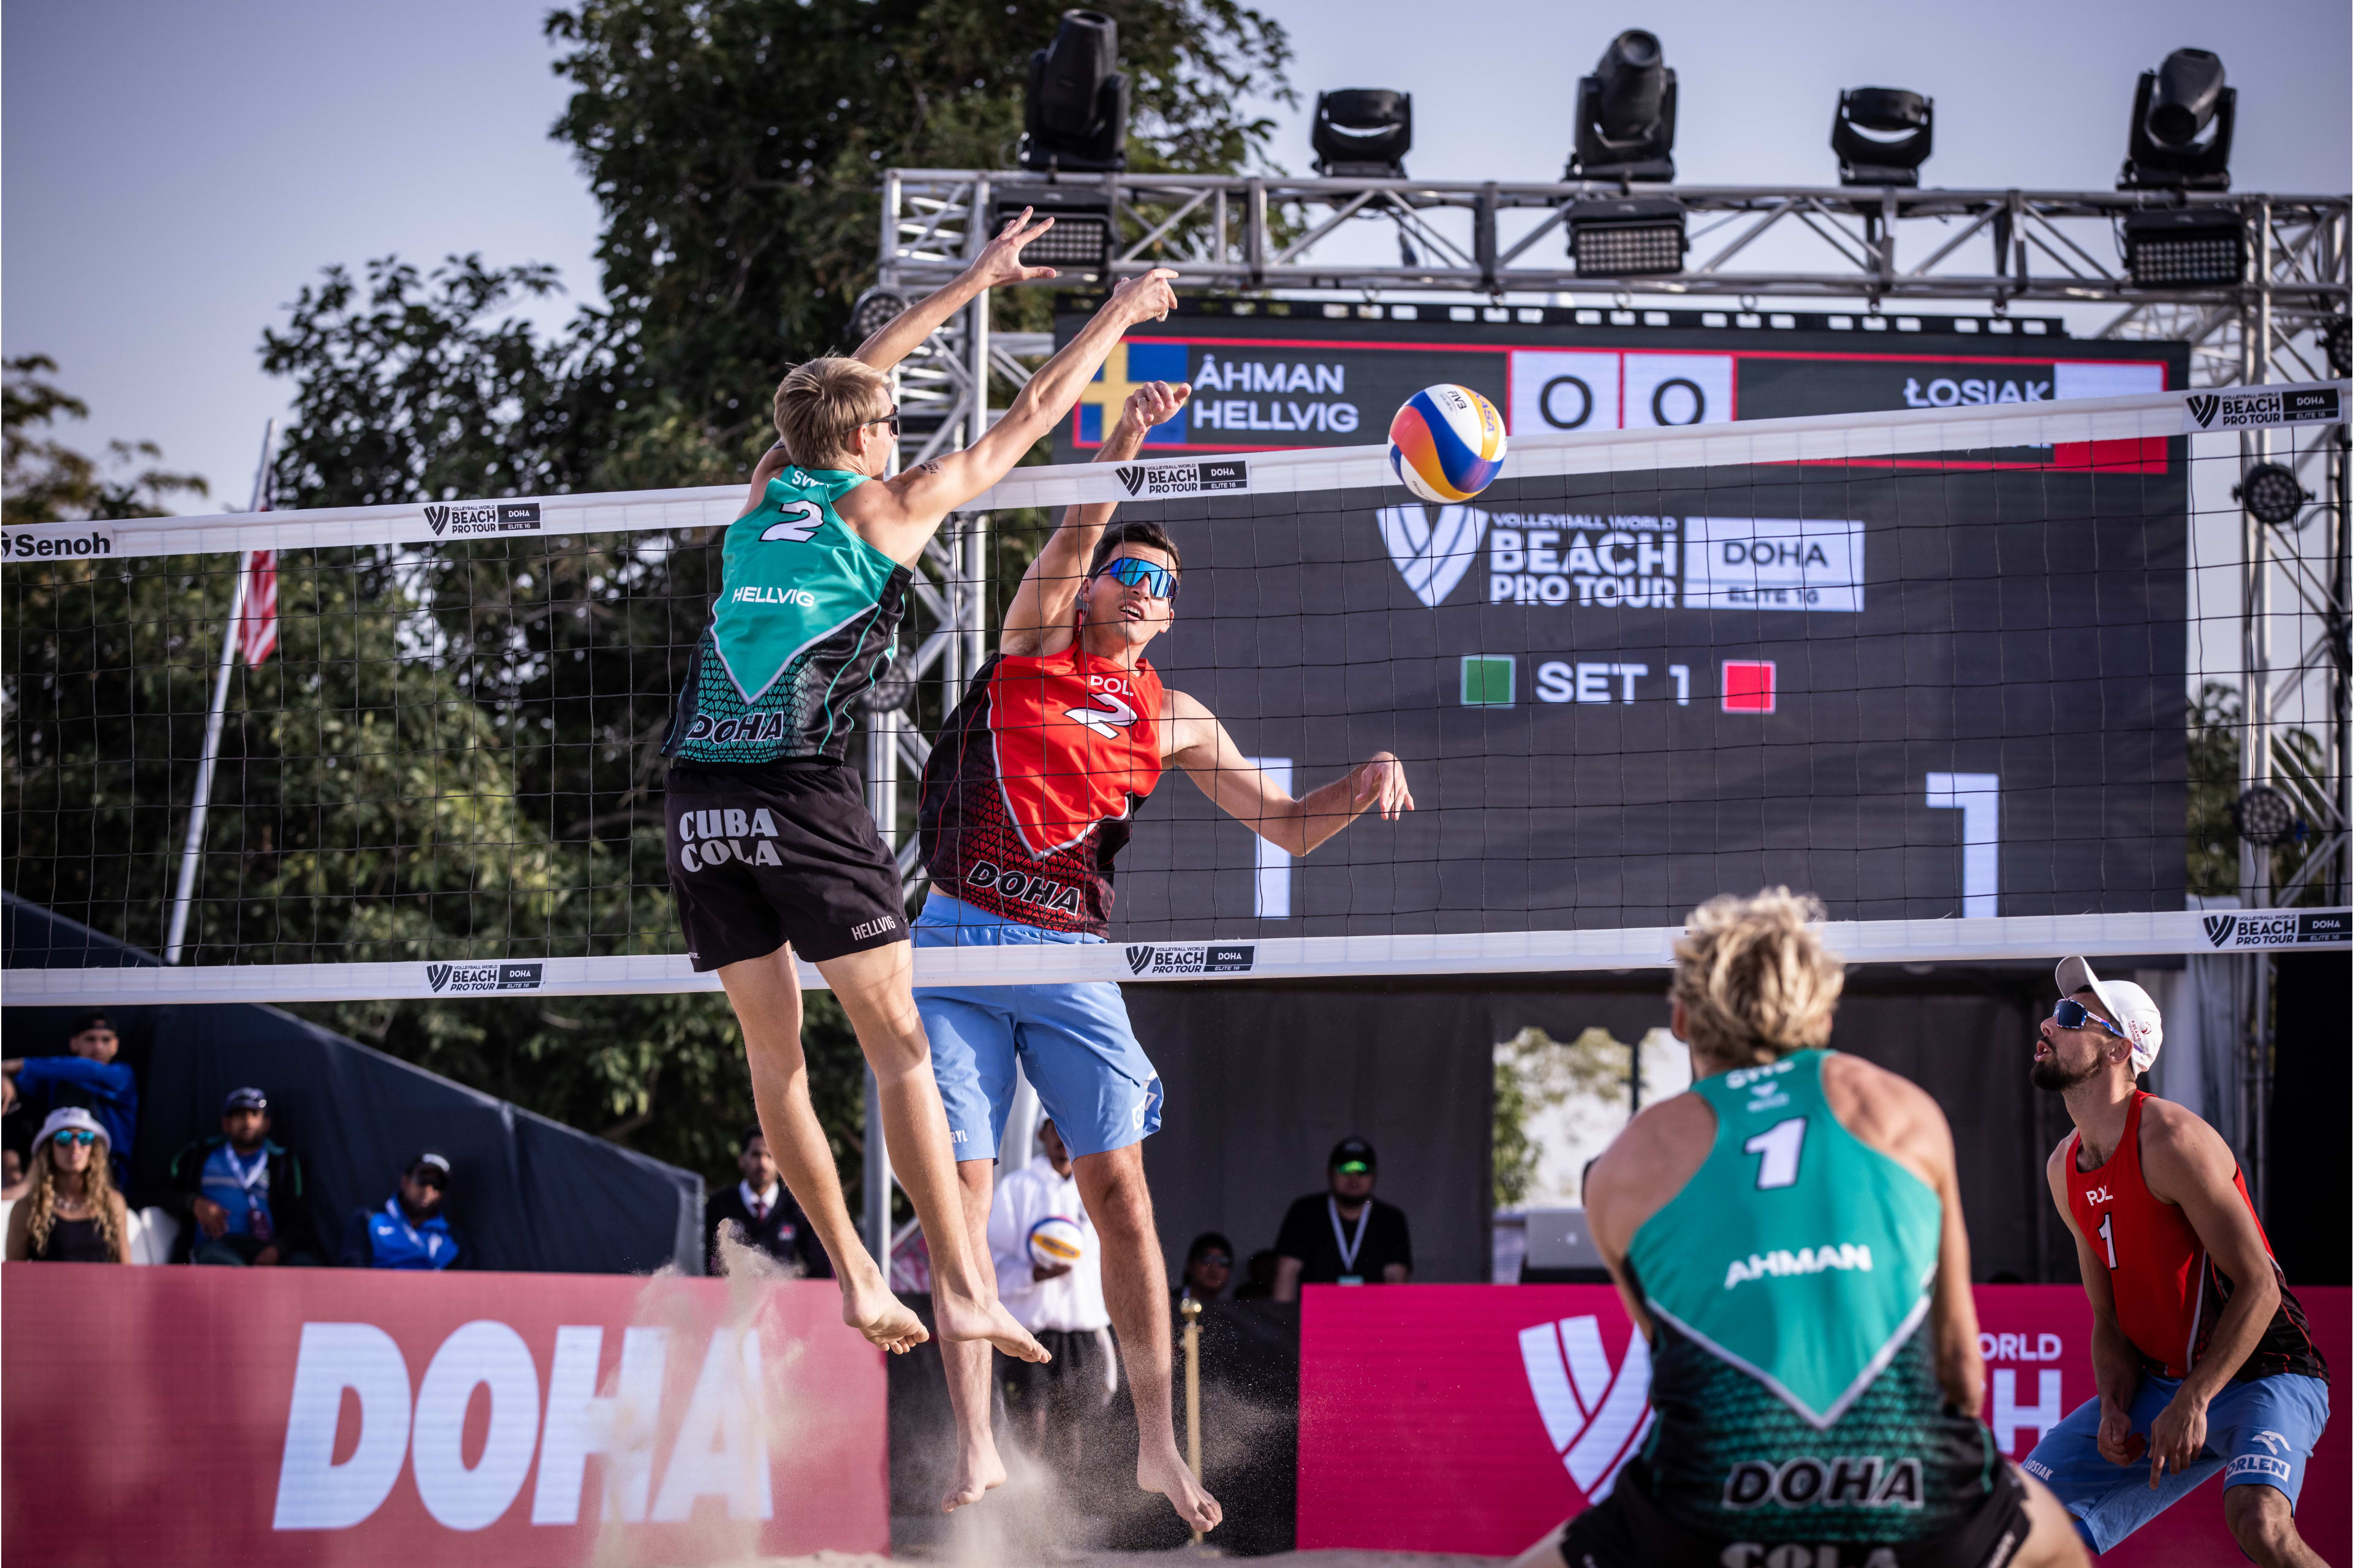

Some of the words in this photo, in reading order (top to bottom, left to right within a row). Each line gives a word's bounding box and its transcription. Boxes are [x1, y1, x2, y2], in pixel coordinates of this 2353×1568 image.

[1194, 354, 1344, 394] ÅHMAN
[2222, 398, 2280, 415] BEACH
[2297, 396, 2325, 406] DOHA
[1194, 400, 1358, 433] HELLVIG
[2223, 415, 2246, 426] PRO
[2248, 413, 2280, 424] TOUR
[1147, 469, 1197, 484] BEACH
[1211, 468, 1235, 477] DOHA
[1149, 483, 1170, 494] PRO
[1172, 482, 1197, 492] TOUR
[452, 510, 496, 525] BEACH
[452, 525, 471, 534] PRO
[472, 523, 496, 533] TOUR
[759, 499, 824, 543] 2
[15, 532, 111, 557] Senoh
[1490, 529, 1678, 576] BEACH
[1724, 542, 1828, 567] DOHA
[731, 586, 815, 607] HELLVIG
[1490, 574, 1570, 607] PRO
[1573, 575, 1677, 608] TOUR
[1728, 586, 1787, 603] ELITE
[1089, 675, 1134, 697] POL
[1535, 661, 1649, 706] SET
[1669, 664, 1690, 706] 1
[1062, 692, 1139, 740] 2
[686, 711, 784, 744] DOHA
[679, 808, 779, 843] CUBA
[681, 839, 783, 873] COLA
[1926, 772, 1999, 918] 1
[966, 859, 1080, 916] DOHA
[851, 915, 896, 941] HELLVIG
[2237, 920, 2296, 936] BEACH
[2312, 920, 2341, 929] DOHA
[2235, 936, 2260, 945] PRO
[2262, 935, 2294, 944] TOUR
[1154, 952, 1205, 965] BEACH
[1175, 964, 1202, 973] TOUR
[450, 983, 471, 991] PRO
[453, 969, 497, 983] BEACH
[2131, 1020, 2142, 1041] POLAND
[951, 1129, 968, 1143] RYL
[1743, 1116, 1807, 1190] 1
[2086, 1184, 2113, 1207] POL
[2097, 1211, 2117, 1270] 1
[1979, 1333, 2062, 1361] ORLD
[273, 1319, 773, 1532] DOHA
[2227, 1456, 2286, 1476] ORLEN
[1722, 1456, 1924, 1510] DOHA
